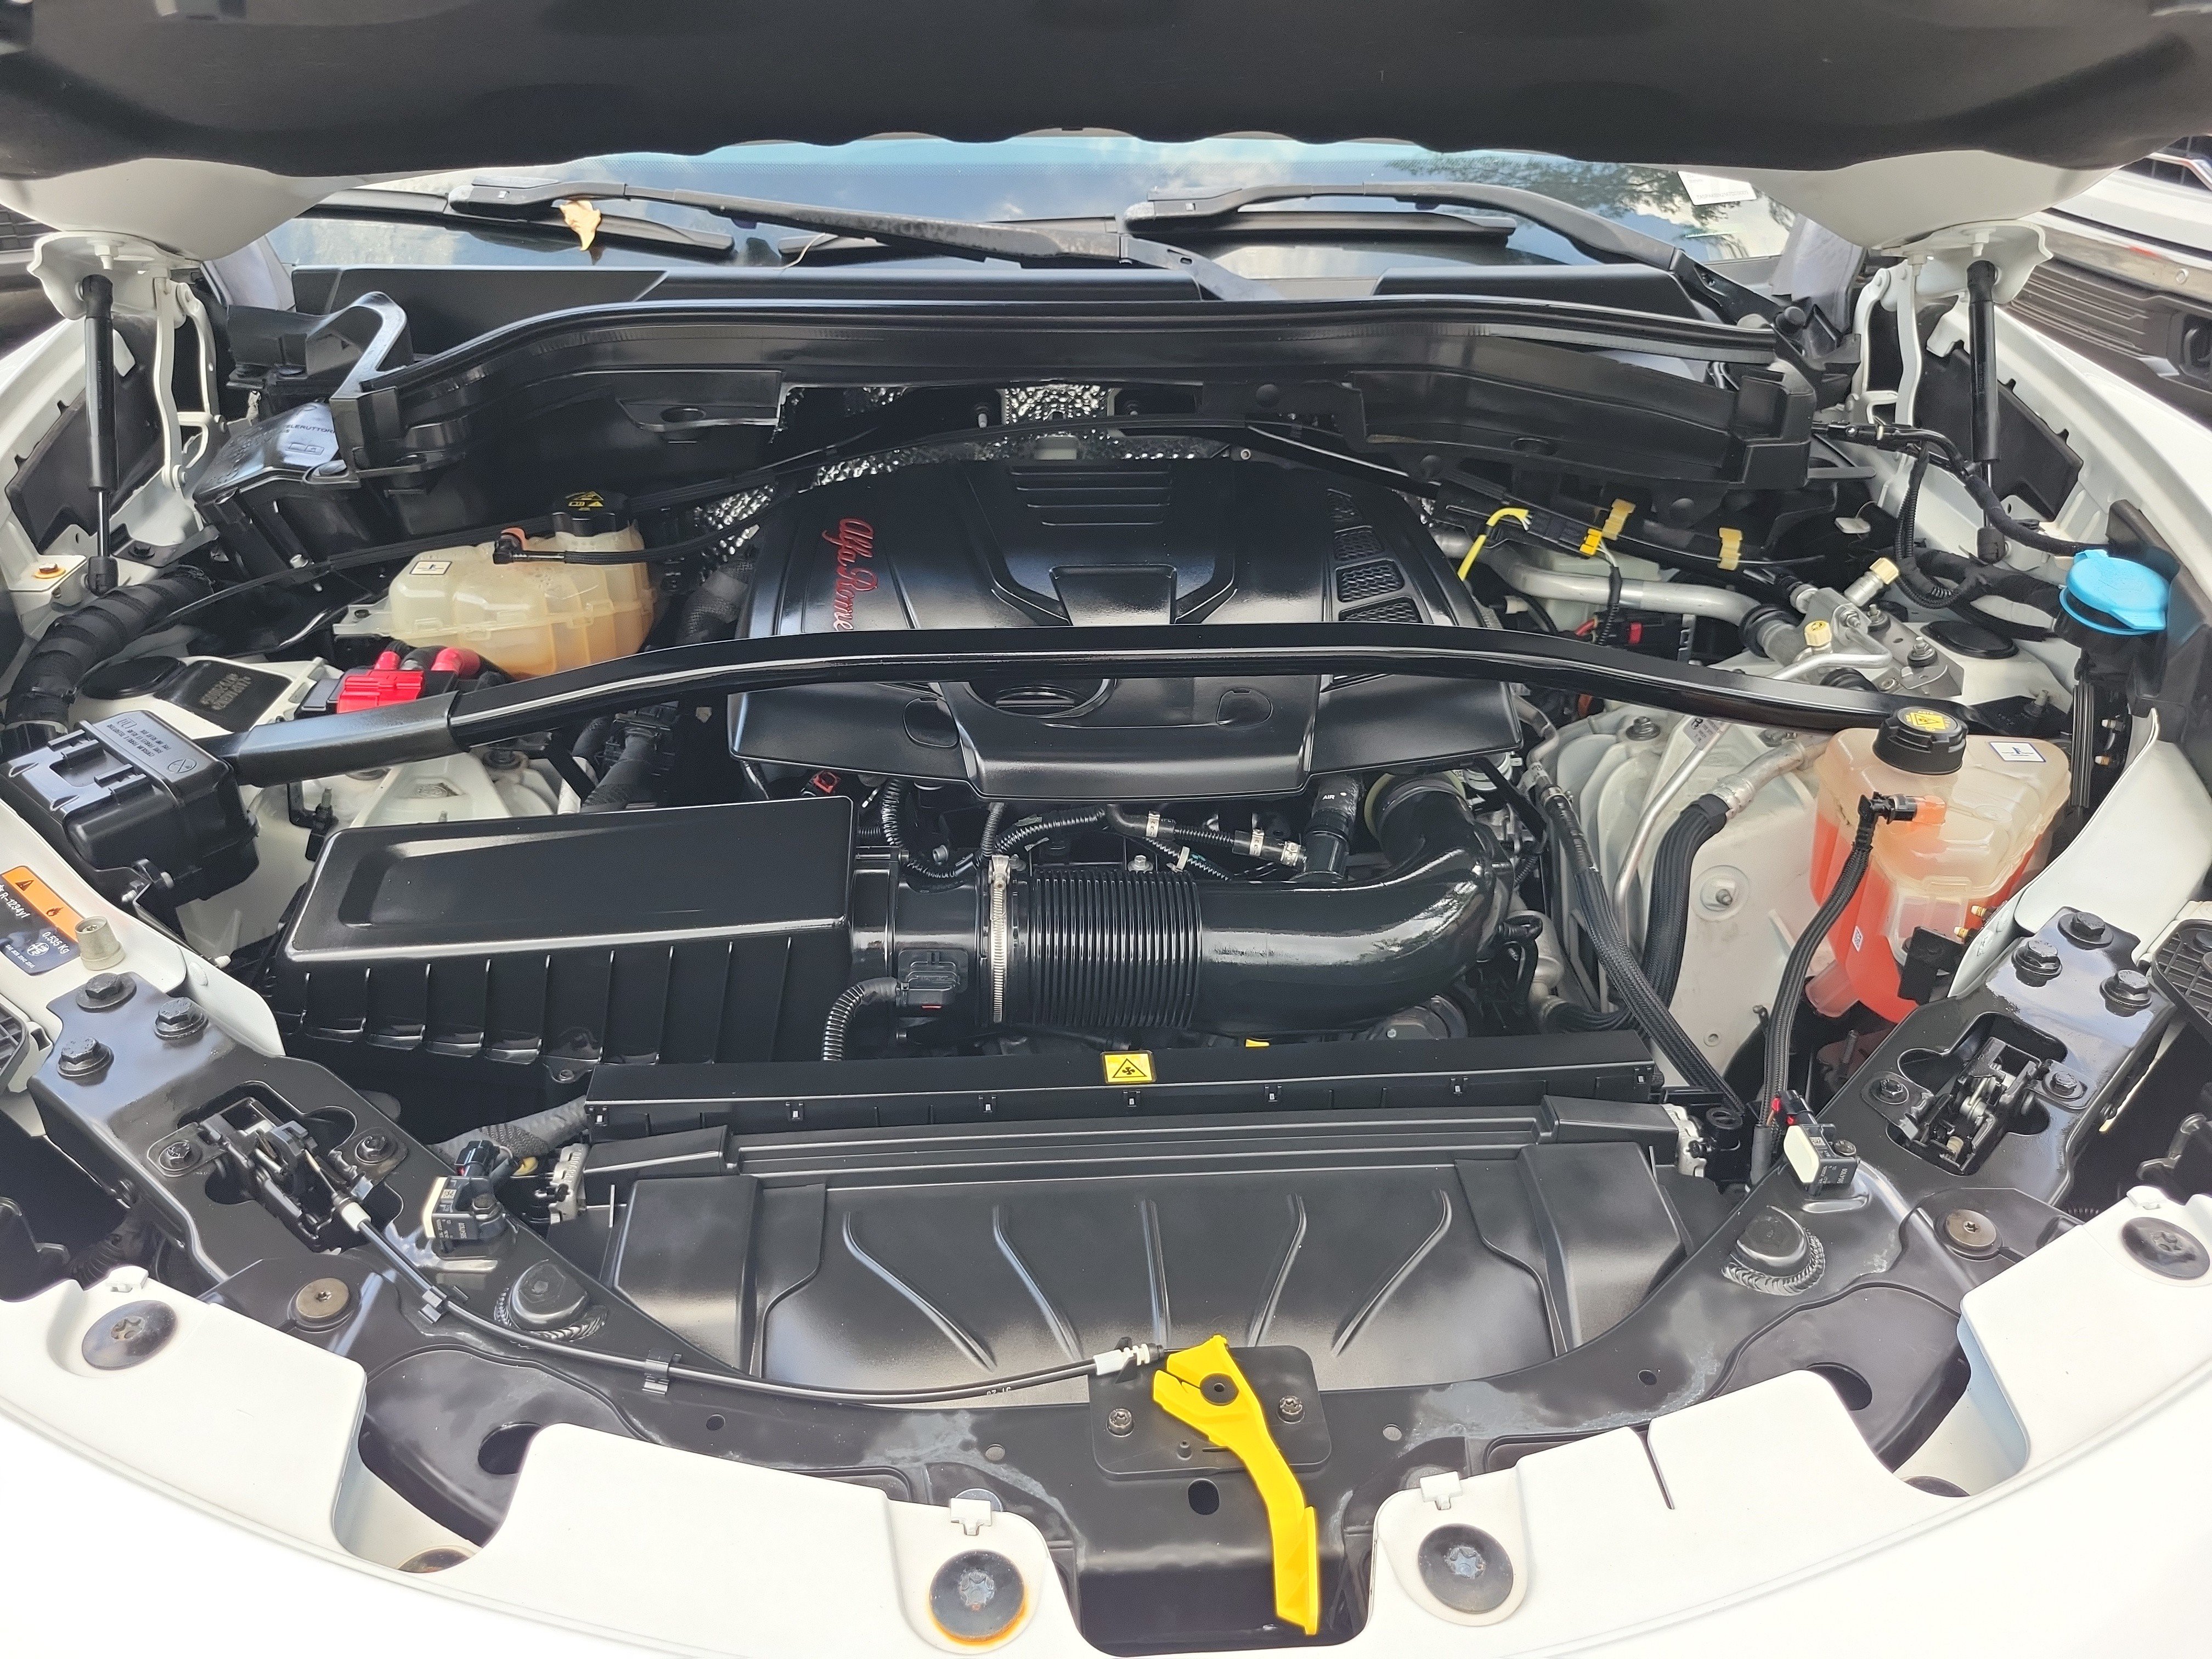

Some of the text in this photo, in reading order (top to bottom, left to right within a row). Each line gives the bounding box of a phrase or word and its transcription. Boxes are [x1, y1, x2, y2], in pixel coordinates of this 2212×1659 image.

[822, 517, 878, 631] Alfa Rome
[0, 891, 31, 918] R-1234yf
[42, 932, 70, 954] 0.535 Kg
